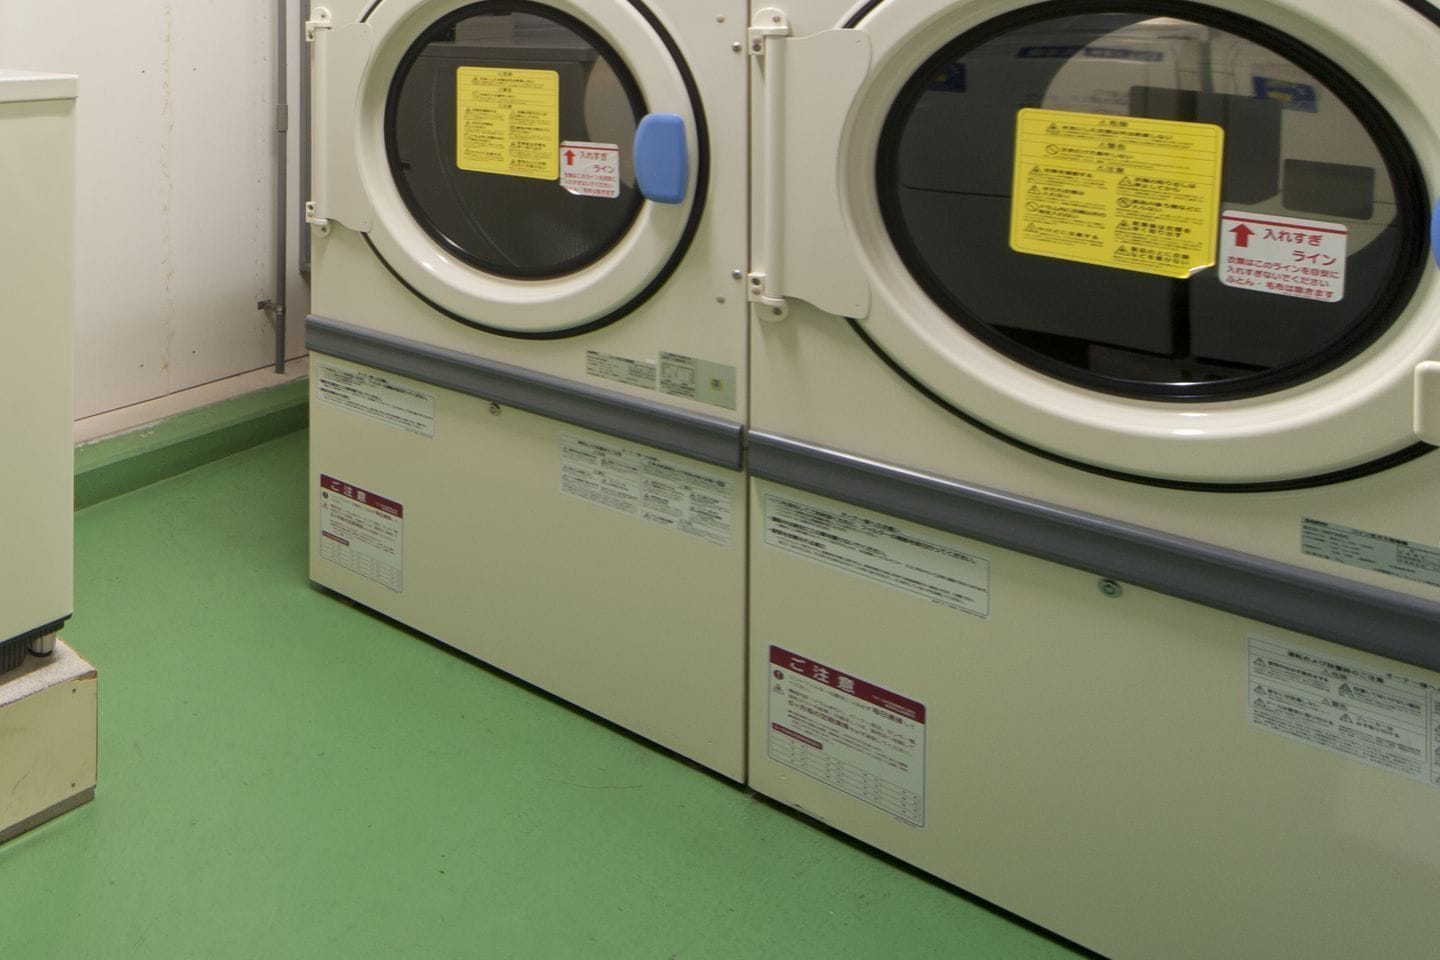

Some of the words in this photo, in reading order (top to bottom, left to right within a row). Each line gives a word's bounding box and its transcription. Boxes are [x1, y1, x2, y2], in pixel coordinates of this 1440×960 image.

[1263, 228, 1322, 247] 入れすぎ
[1226, 256, 1340, 279] 衣類はこのラインを目安に
[1292, 250, 1337, 266] ライン
[789, 657, 856, 694] ご注意
